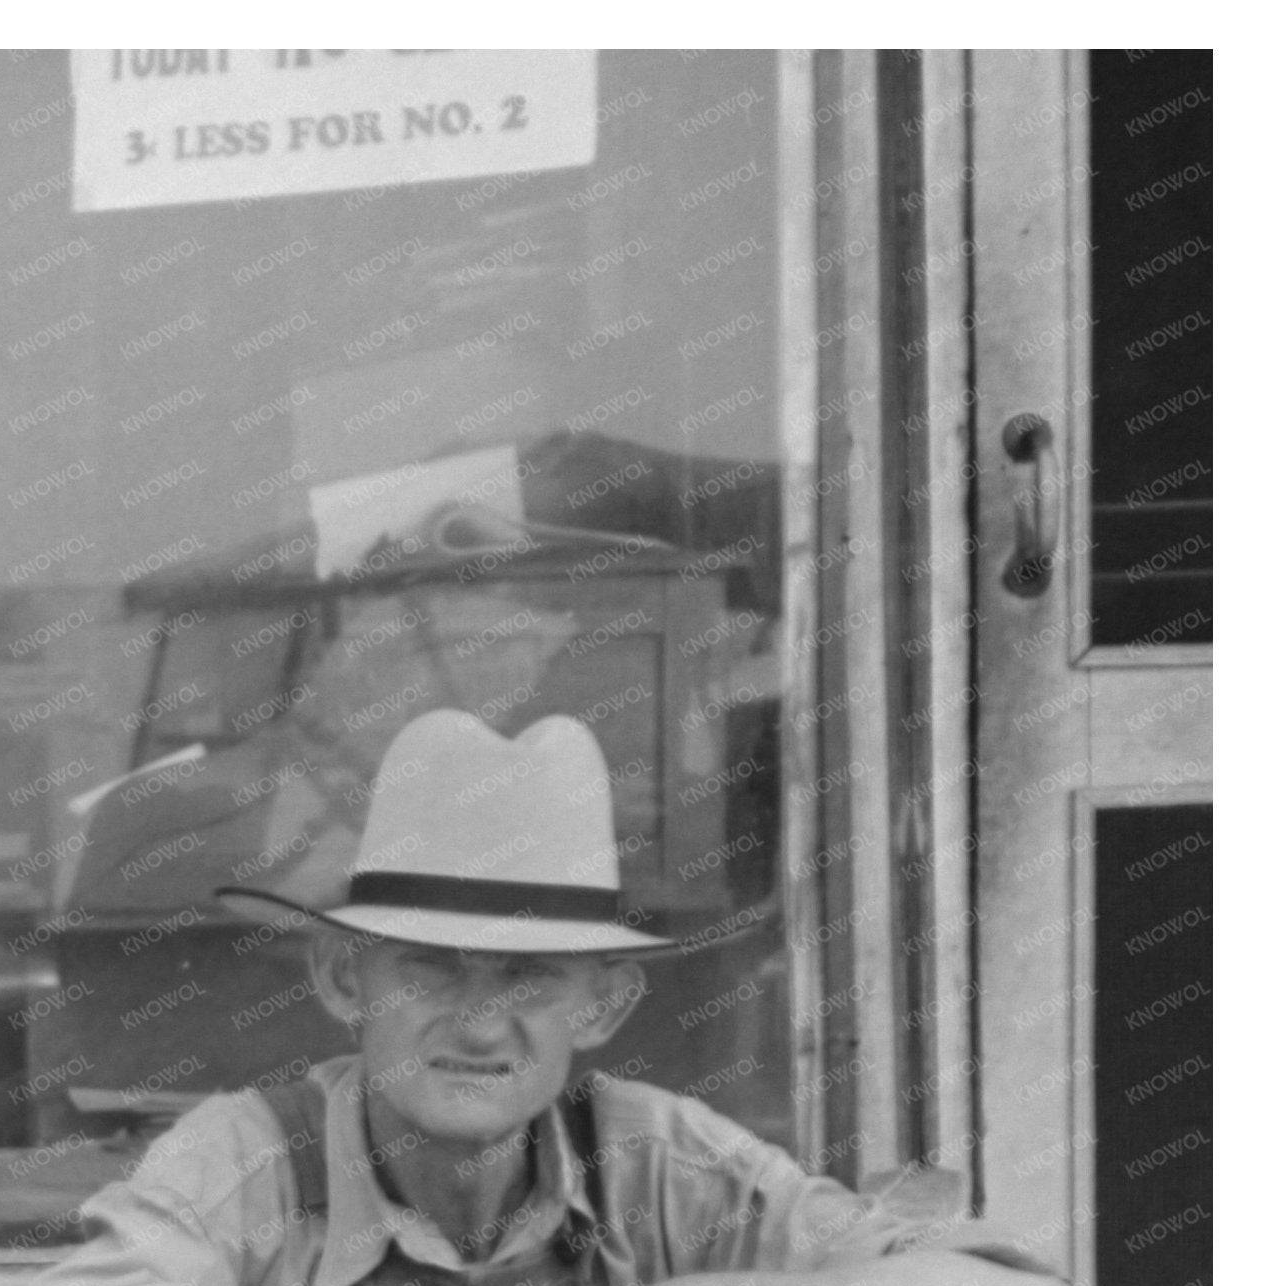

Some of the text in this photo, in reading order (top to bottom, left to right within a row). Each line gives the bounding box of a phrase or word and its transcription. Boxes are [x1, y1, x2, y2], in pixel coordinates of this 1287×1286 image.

[174, 120, 271, 160] LESS
[288, 110, 384, 151] FOR
[402, 100, 484, 140] NO.
[500, 94, 529, 131] 2
